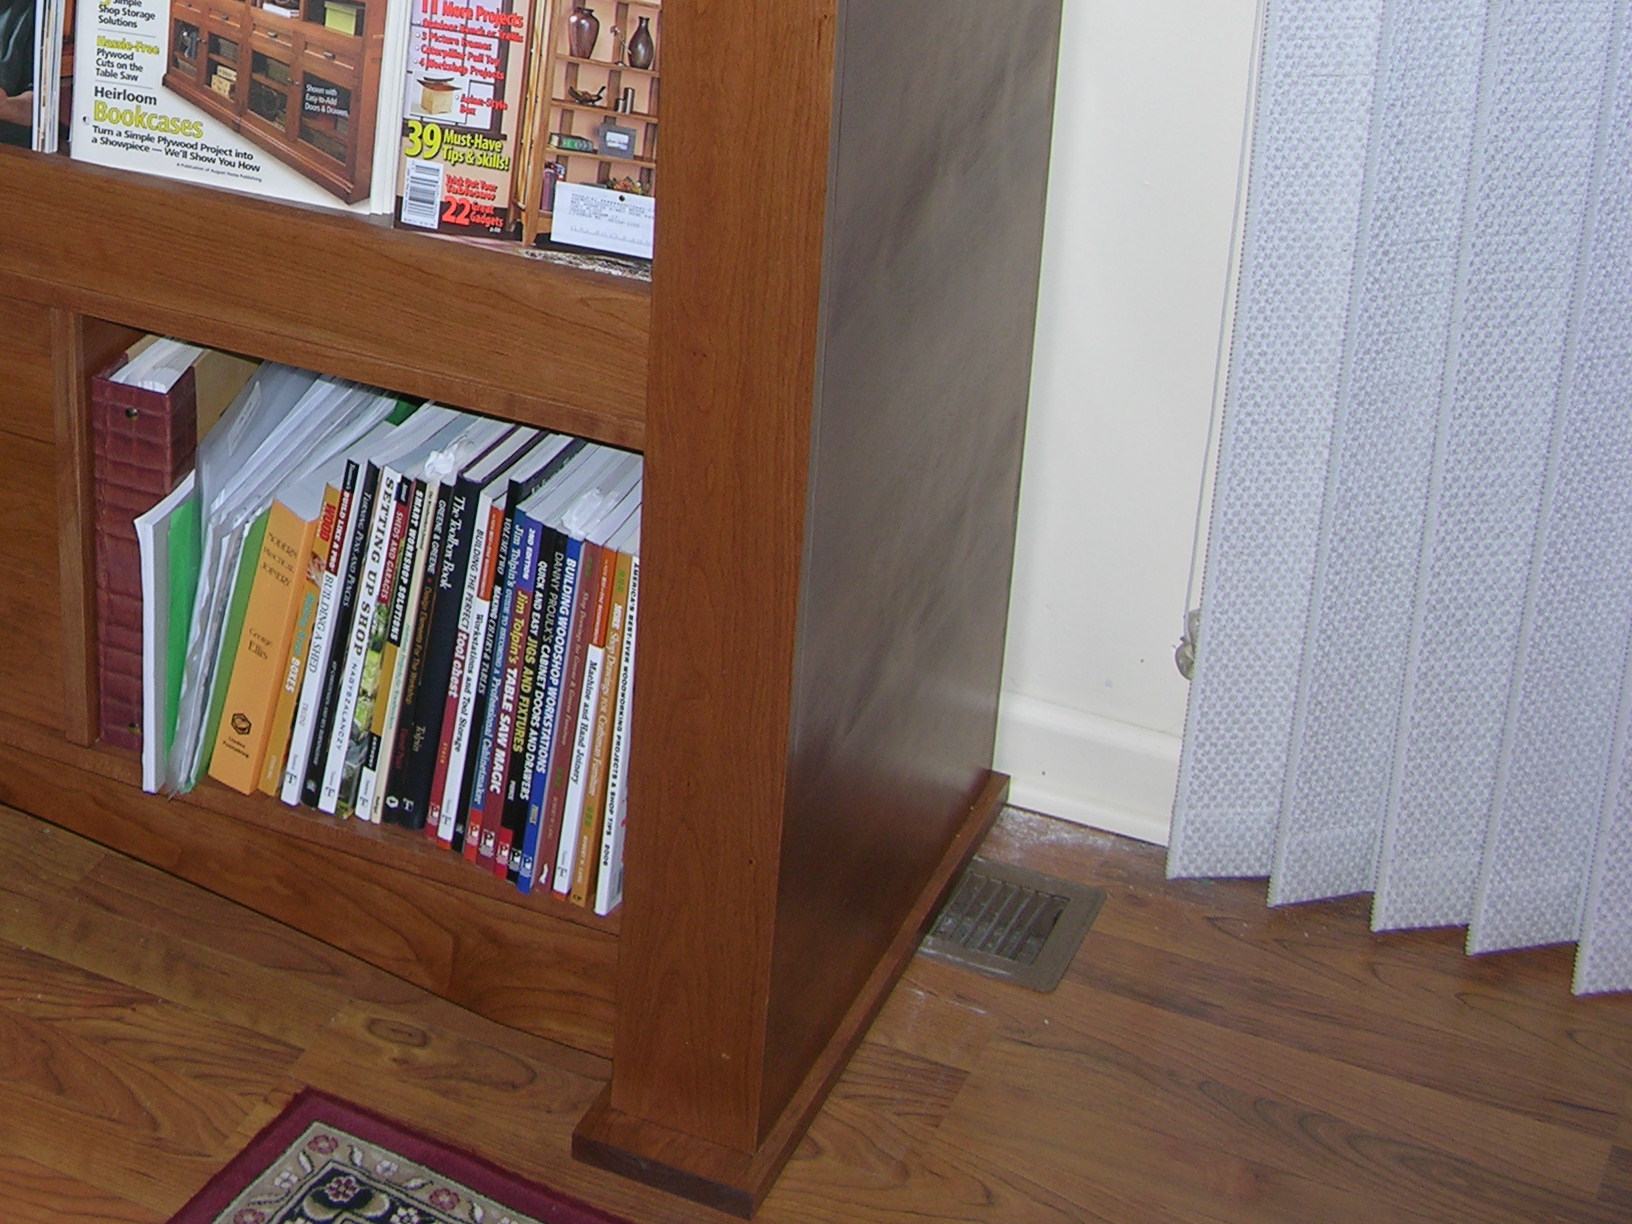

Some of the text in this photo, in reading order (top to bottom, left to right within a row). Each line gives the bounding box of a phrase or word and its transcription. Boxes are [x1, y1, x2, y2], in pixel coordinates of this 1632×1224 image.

[92, 101, 204, 139] Bookcases
[94, 86, 158, 106] Heirloom
[404, 120, 443, 159] 39
[443, 129, 503, 152] Must-Have
[443, 148, 510, 171] Tips & Skills!
[442, 197, 494, 226] 22 Great
[470, 212, 504, 227] Gadgets
[353, 476, 394, 656] SETTING UP SHOP
[390, 489, 424, 642] SMART WORKSHOP SOLUTIONS
[439, 496, 466, 590] The Toolbox Book
[559, 557, 577, 616] BUILDING
[549, 615, 568, 681] WOODSHOP
[490, 667, 518, 794] TABLE SAW MAGIC
[535, 682, 557, 774] WORKSTATIONS
